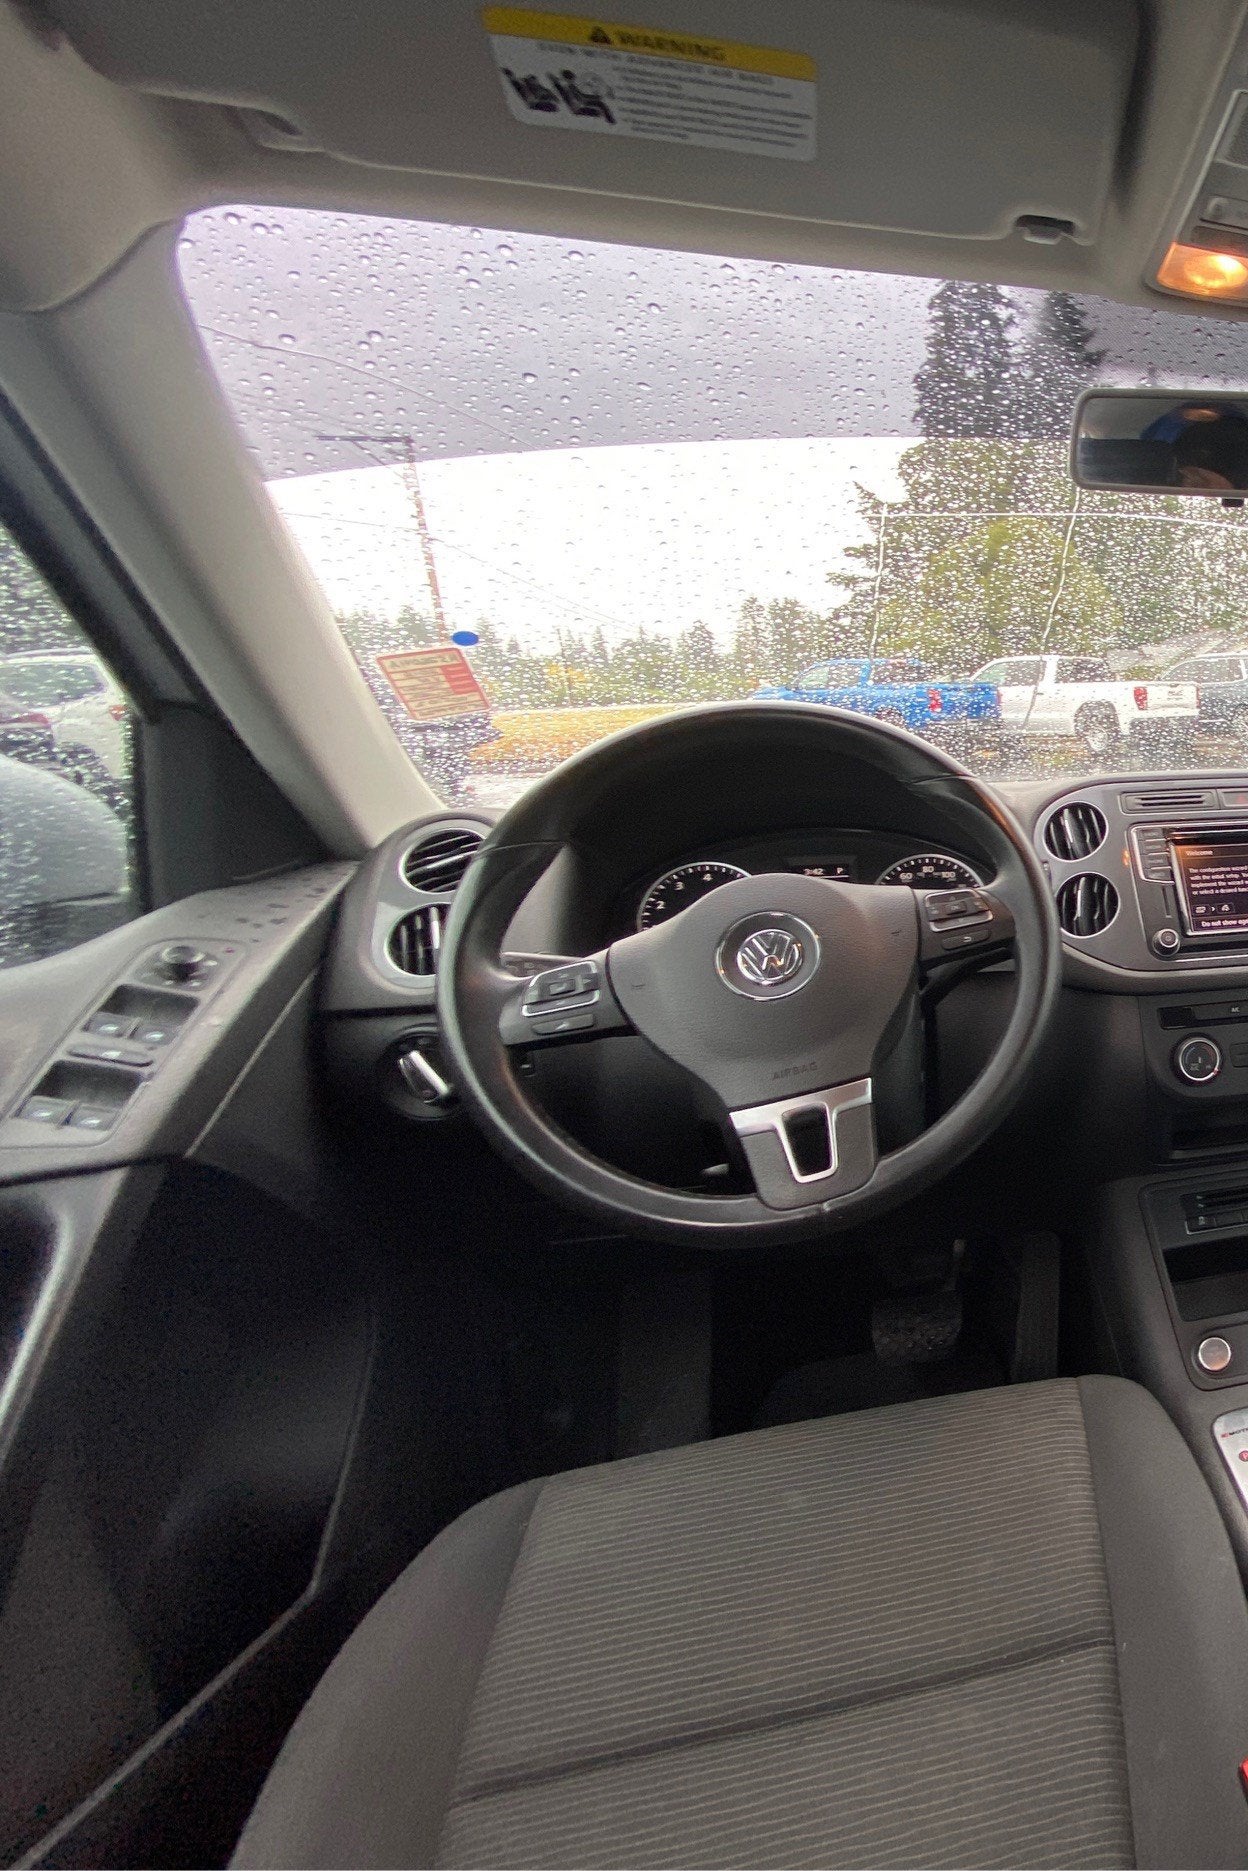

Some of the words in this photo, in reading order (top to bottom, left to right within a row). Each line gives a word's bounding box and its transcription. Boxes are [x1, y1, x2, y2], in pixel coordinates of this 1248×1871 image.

[922, 865, 934, 873] 80
[702, 873, 713, 882] 4
[899, 872, 913, 880] 60
[674, 881, 684, 891] 3
[656, 900, 665, 910] 2
[772, 1062, 818, 1081] AIRBAG
